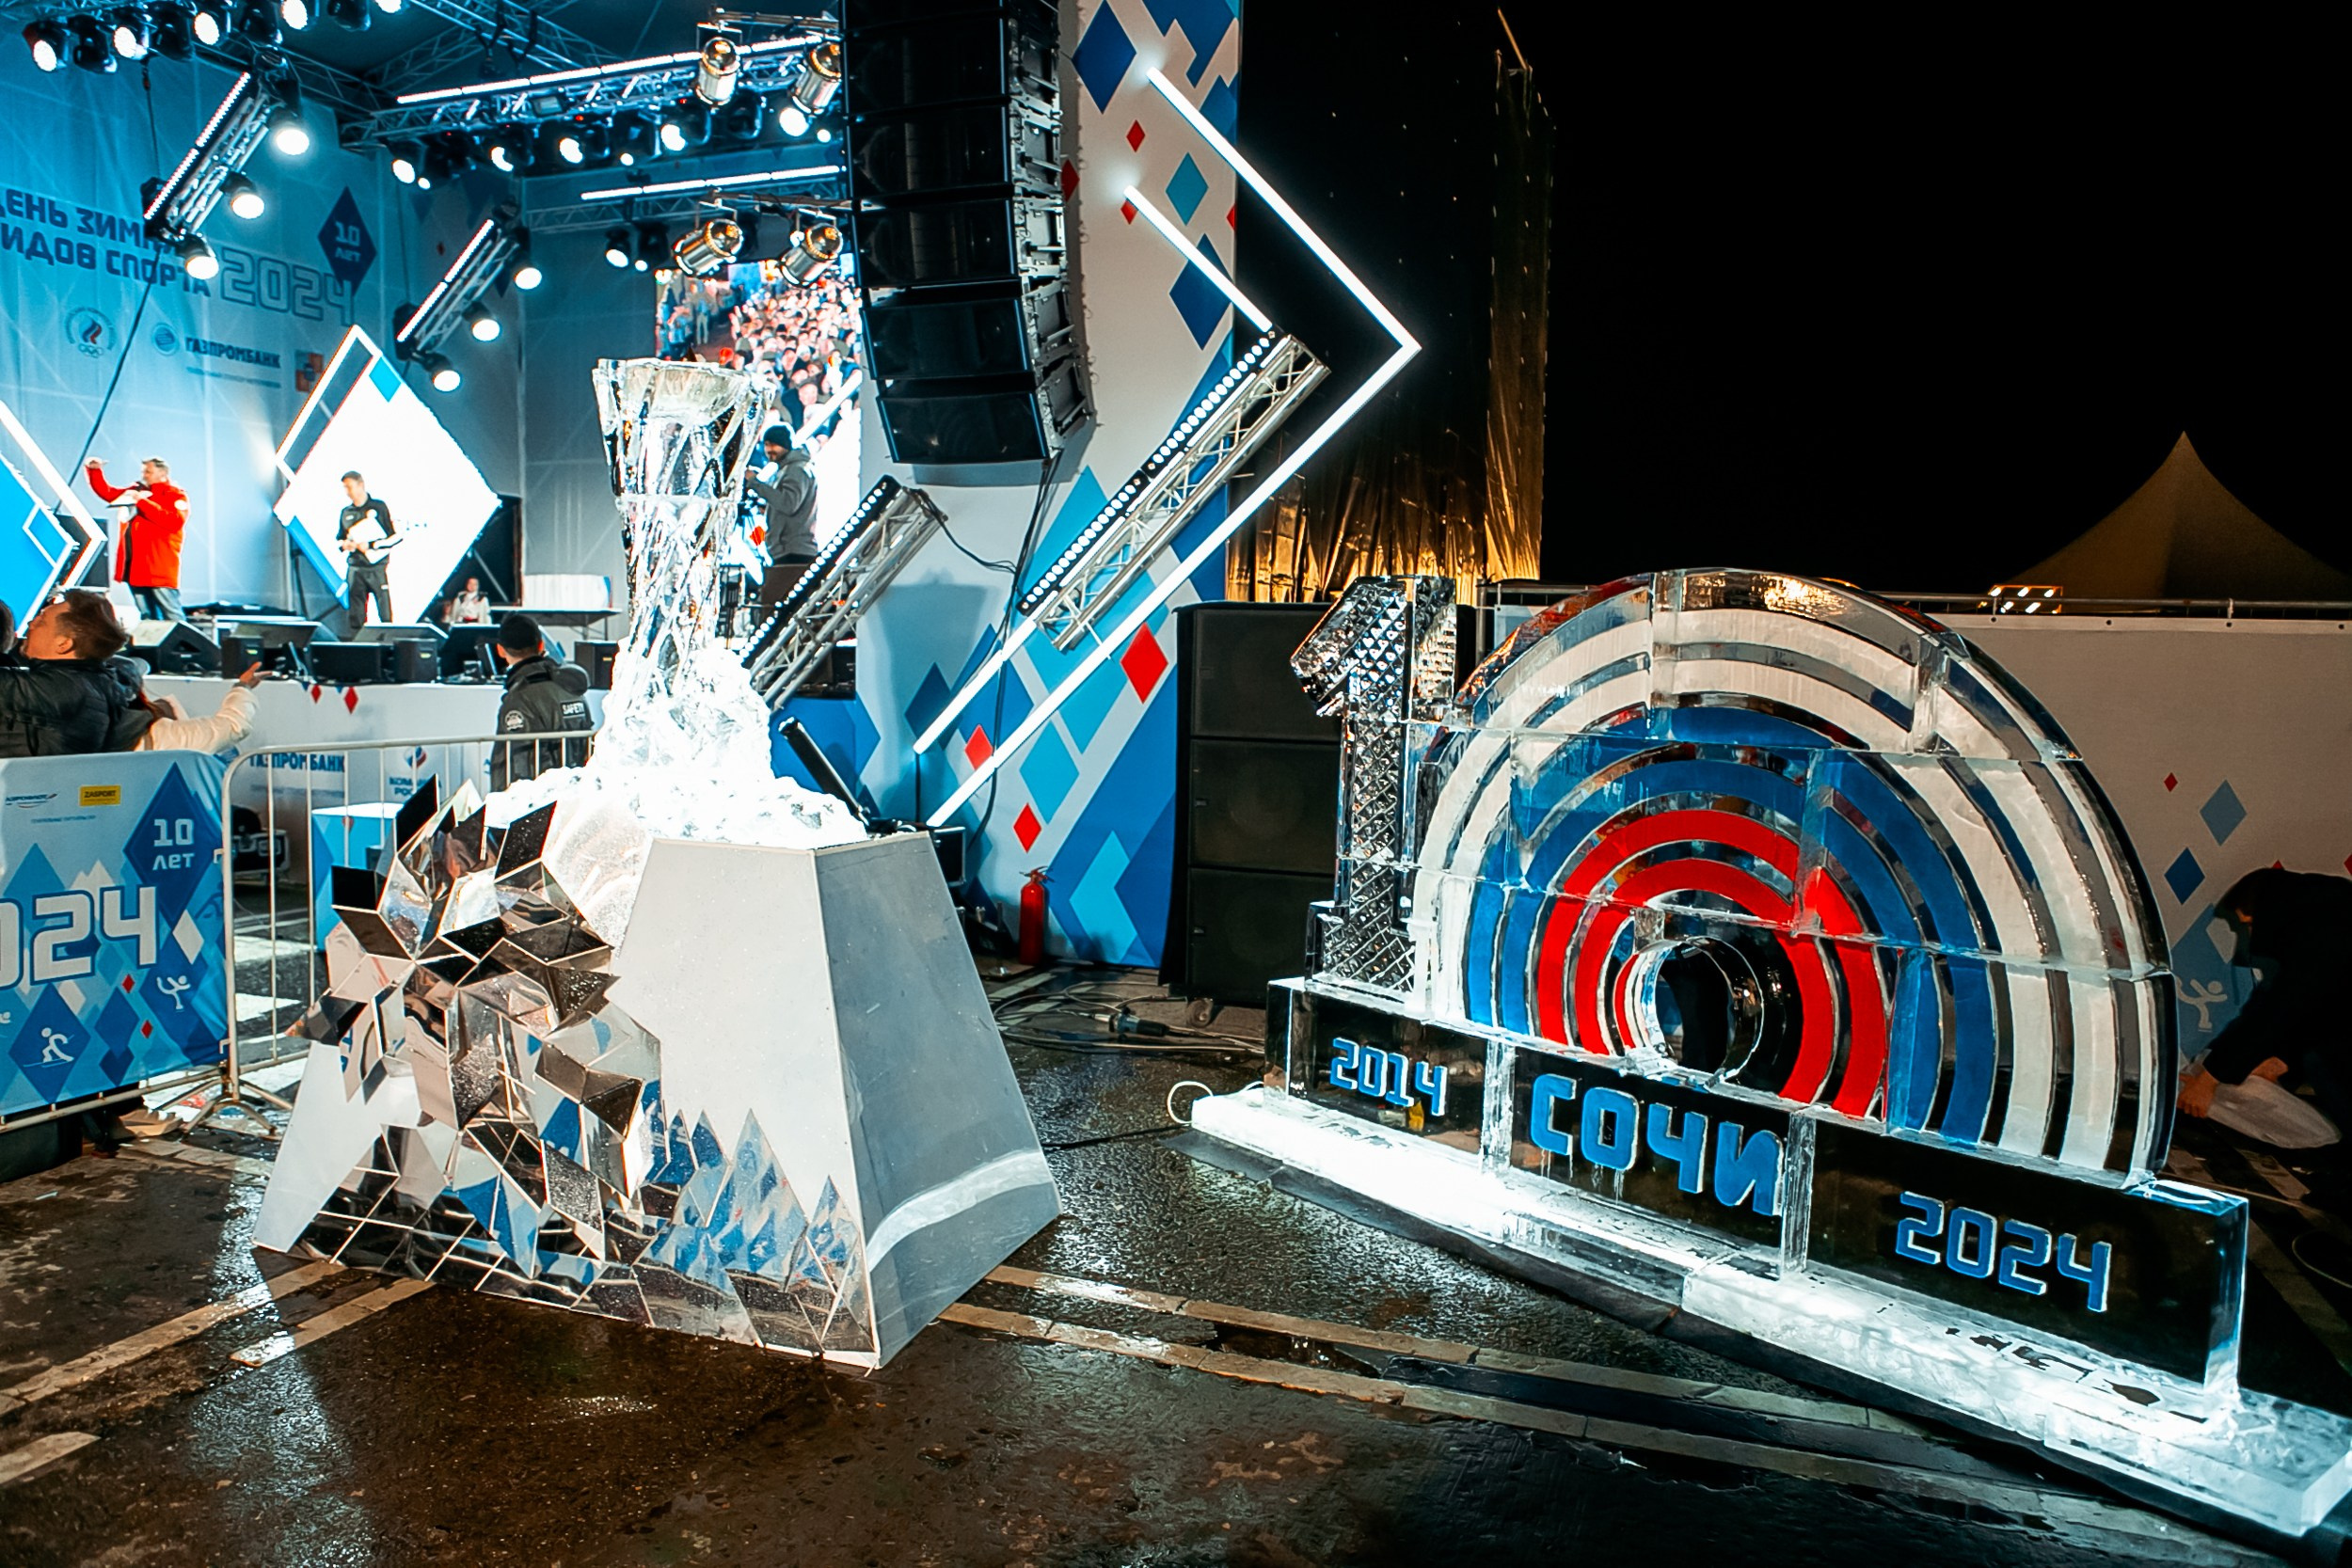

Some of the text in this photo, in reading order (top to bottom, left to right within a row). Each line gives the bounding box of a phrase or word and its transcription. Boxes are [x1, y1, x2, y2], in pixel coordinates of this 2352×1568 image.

[335, 221, 360, 246] 10
[220, 245, 355, 328] 2024
[185, 337, 281, 369] ГАЗПРОМБАНК
[153, 818, 194, 847] 10
[1329, 1037, 2112, 1313] 2014 СОЧИ 2024
